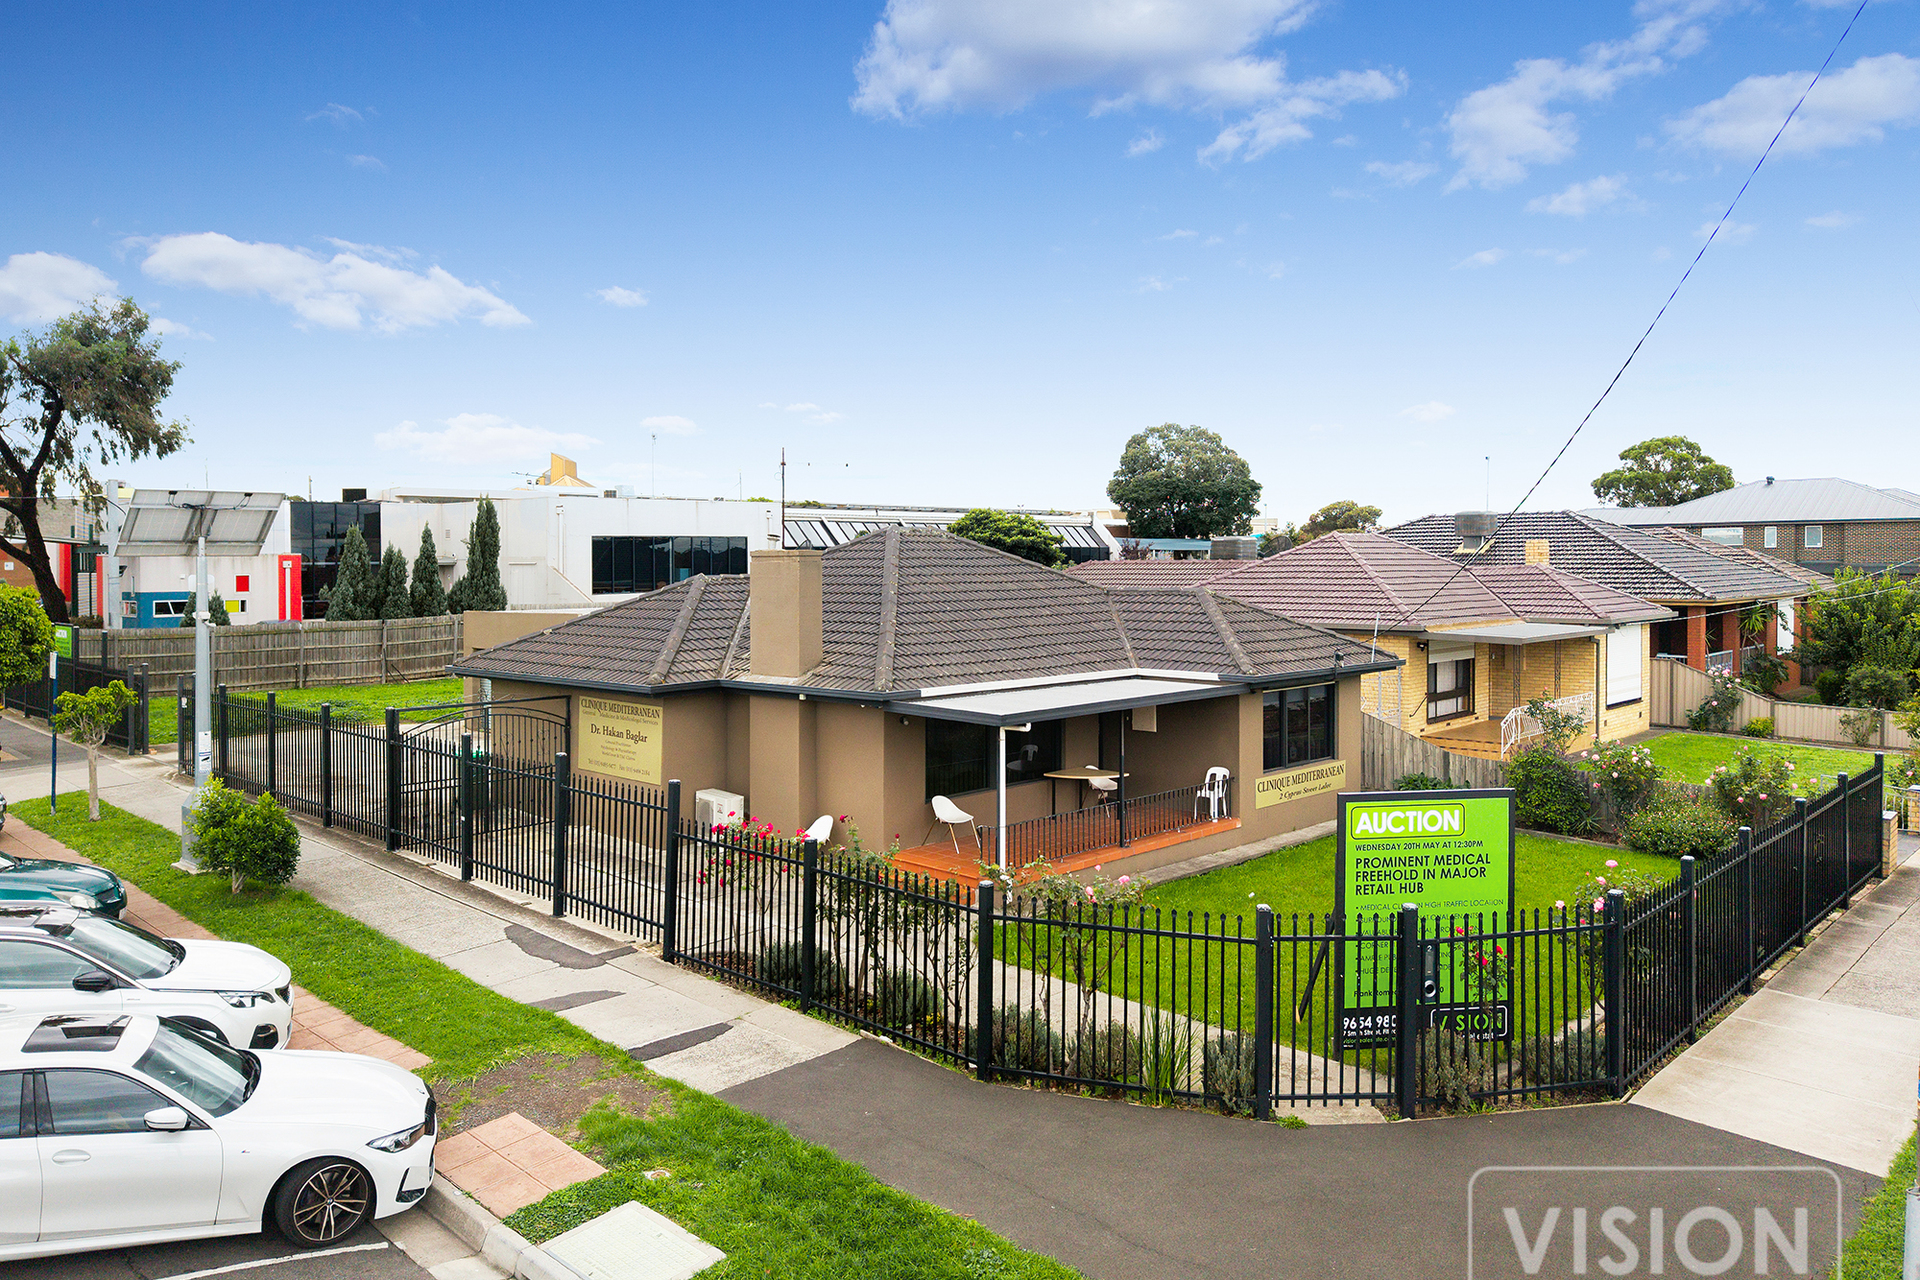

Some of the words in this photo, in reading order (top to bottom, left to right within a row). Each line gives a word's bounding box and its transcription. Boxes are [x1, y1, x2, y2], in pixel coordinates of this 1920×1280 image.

[581, 698, 607, 713] CLINIQUE
[608, 702, 660, 719] MEDITERRANEAN
[590, 723, 601, 735] Dr.
[602, 725, 624, 739] Hakan
[625, 729, 648, 744] Baglar
[1257, 775, 1291, 794] CLINIQUE
[1291, 764, 1345, 786] MEDITERRANEAN
[1303, 786, 1318, 794] Street
[1355, 809, 1460, 834] AUCTION
[1355, 842, 1401, 852] WEDNESDAY
[1403, 842, 1421, 850] 20TH
[1422, 841, 1440, 849] MAY
[1442, 841, 1452, 849] AT
[1453, 840, 1484, 848] 12:30PM
[1355, 855, 1430, 869] PROMINENT
[1433, 853, 1491, 866] MEDICAL
[1355, 869, 1419, 882] FREEHOLD
[1422, 868, 1436, 880] IN
[1440, 866, 1487, 879] MAJOR
[1355, 883, 1395, 895] RETAIL
[1399, 882, 1424, 894] HUB
[1360, 903, 1390, 911] MEDICAL
[1443, 899, 1469, 908] TRAFFIC
[1470, 898, 1504, 907] LOCATION
[1343, 1015, 1373, 1030] 9654
[1436, 1012, 1503, 1031] VSION
